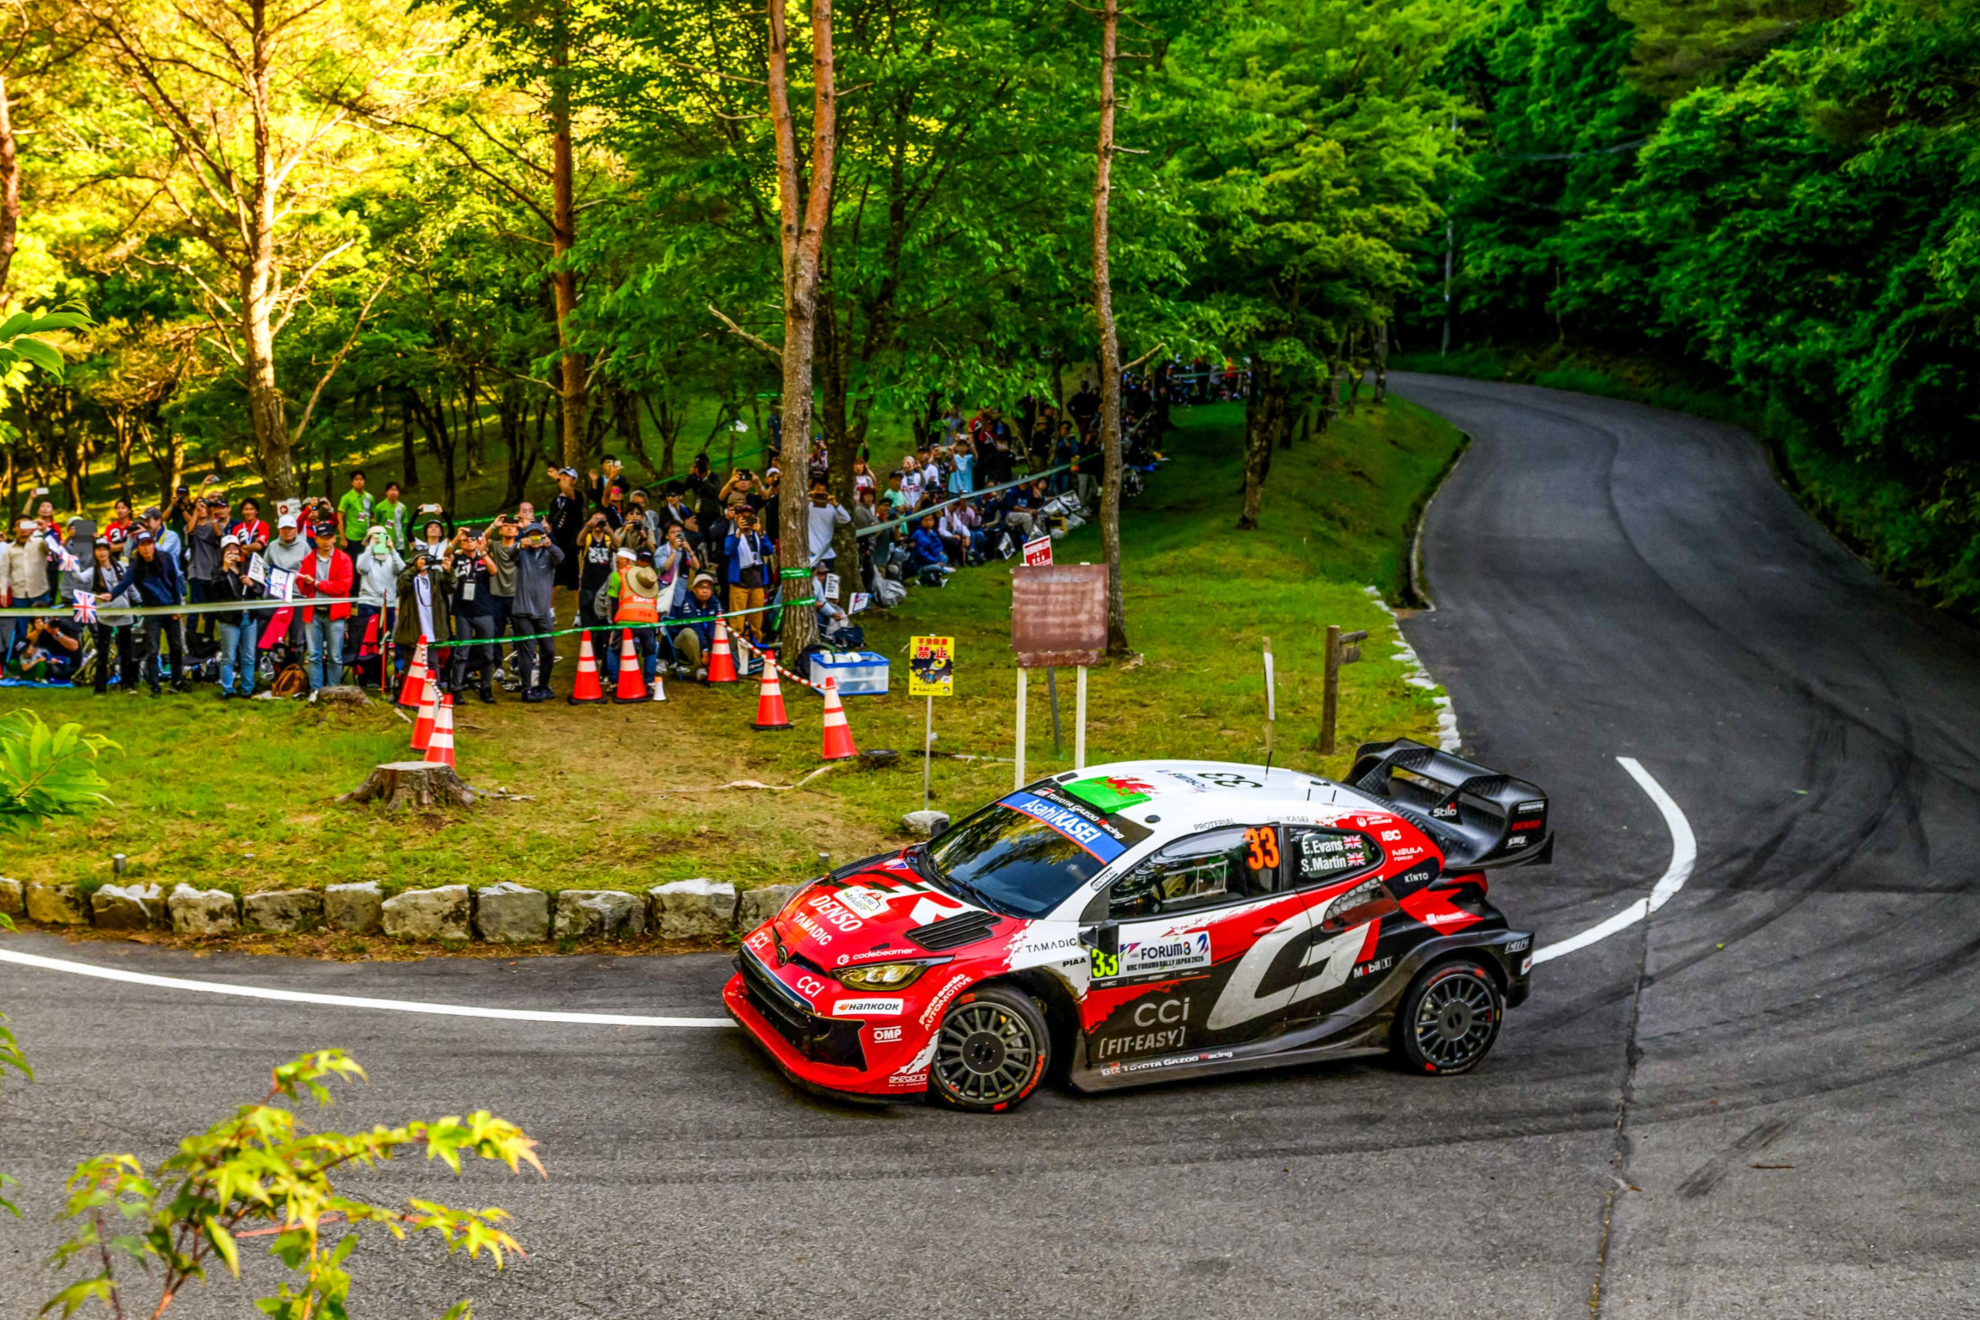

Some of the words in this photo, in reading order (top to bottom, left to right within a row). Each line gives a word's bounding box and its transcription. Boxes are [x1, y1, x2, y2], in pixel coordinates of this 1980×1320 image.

[917, 646, 949, 659] 禁止
[1047, 793, 1075, 809] TOYOTA
[1071, 804, 1100, 822] GAZOO
[1097, 819, 1125, 839] Racing
[1433, 803, 1457, 818] Stilo
[1020, 799, 1102, 844] AsahiKASEI
[1244, 826, 1280, 870] 33
[1302, 840, 1344, 855] E.Evans
[1301, 857, 1347, 873] S.Martin
[1404, 872, 1429, 883] KINTO
[808, 894, 863, 932] DENSO
[793, 912, 832, 945] TAMADIC
[853, 948, 914, 960] codebeamer
[1026, 938, 1077, 953] TAMADIC
[1141, 941, 1191, 960] FORUM8
[1062, 957, 1086, 967] PIAA
[1092, 948, 1119, 978] 33
[1353, 961, 1380, 978] Mobil
[919, 974, 966, 1025] Panasonic
[924, 976, 973, 1031] AUTOMOTIVE
[874, 1029, 902, 1041] OMP
[1122, 1061, 1162, 1072] TOYOTA
[1163, 1056, 1199, 1066] GAZOO
[1200, 1051, 1233, 1060] Racing
